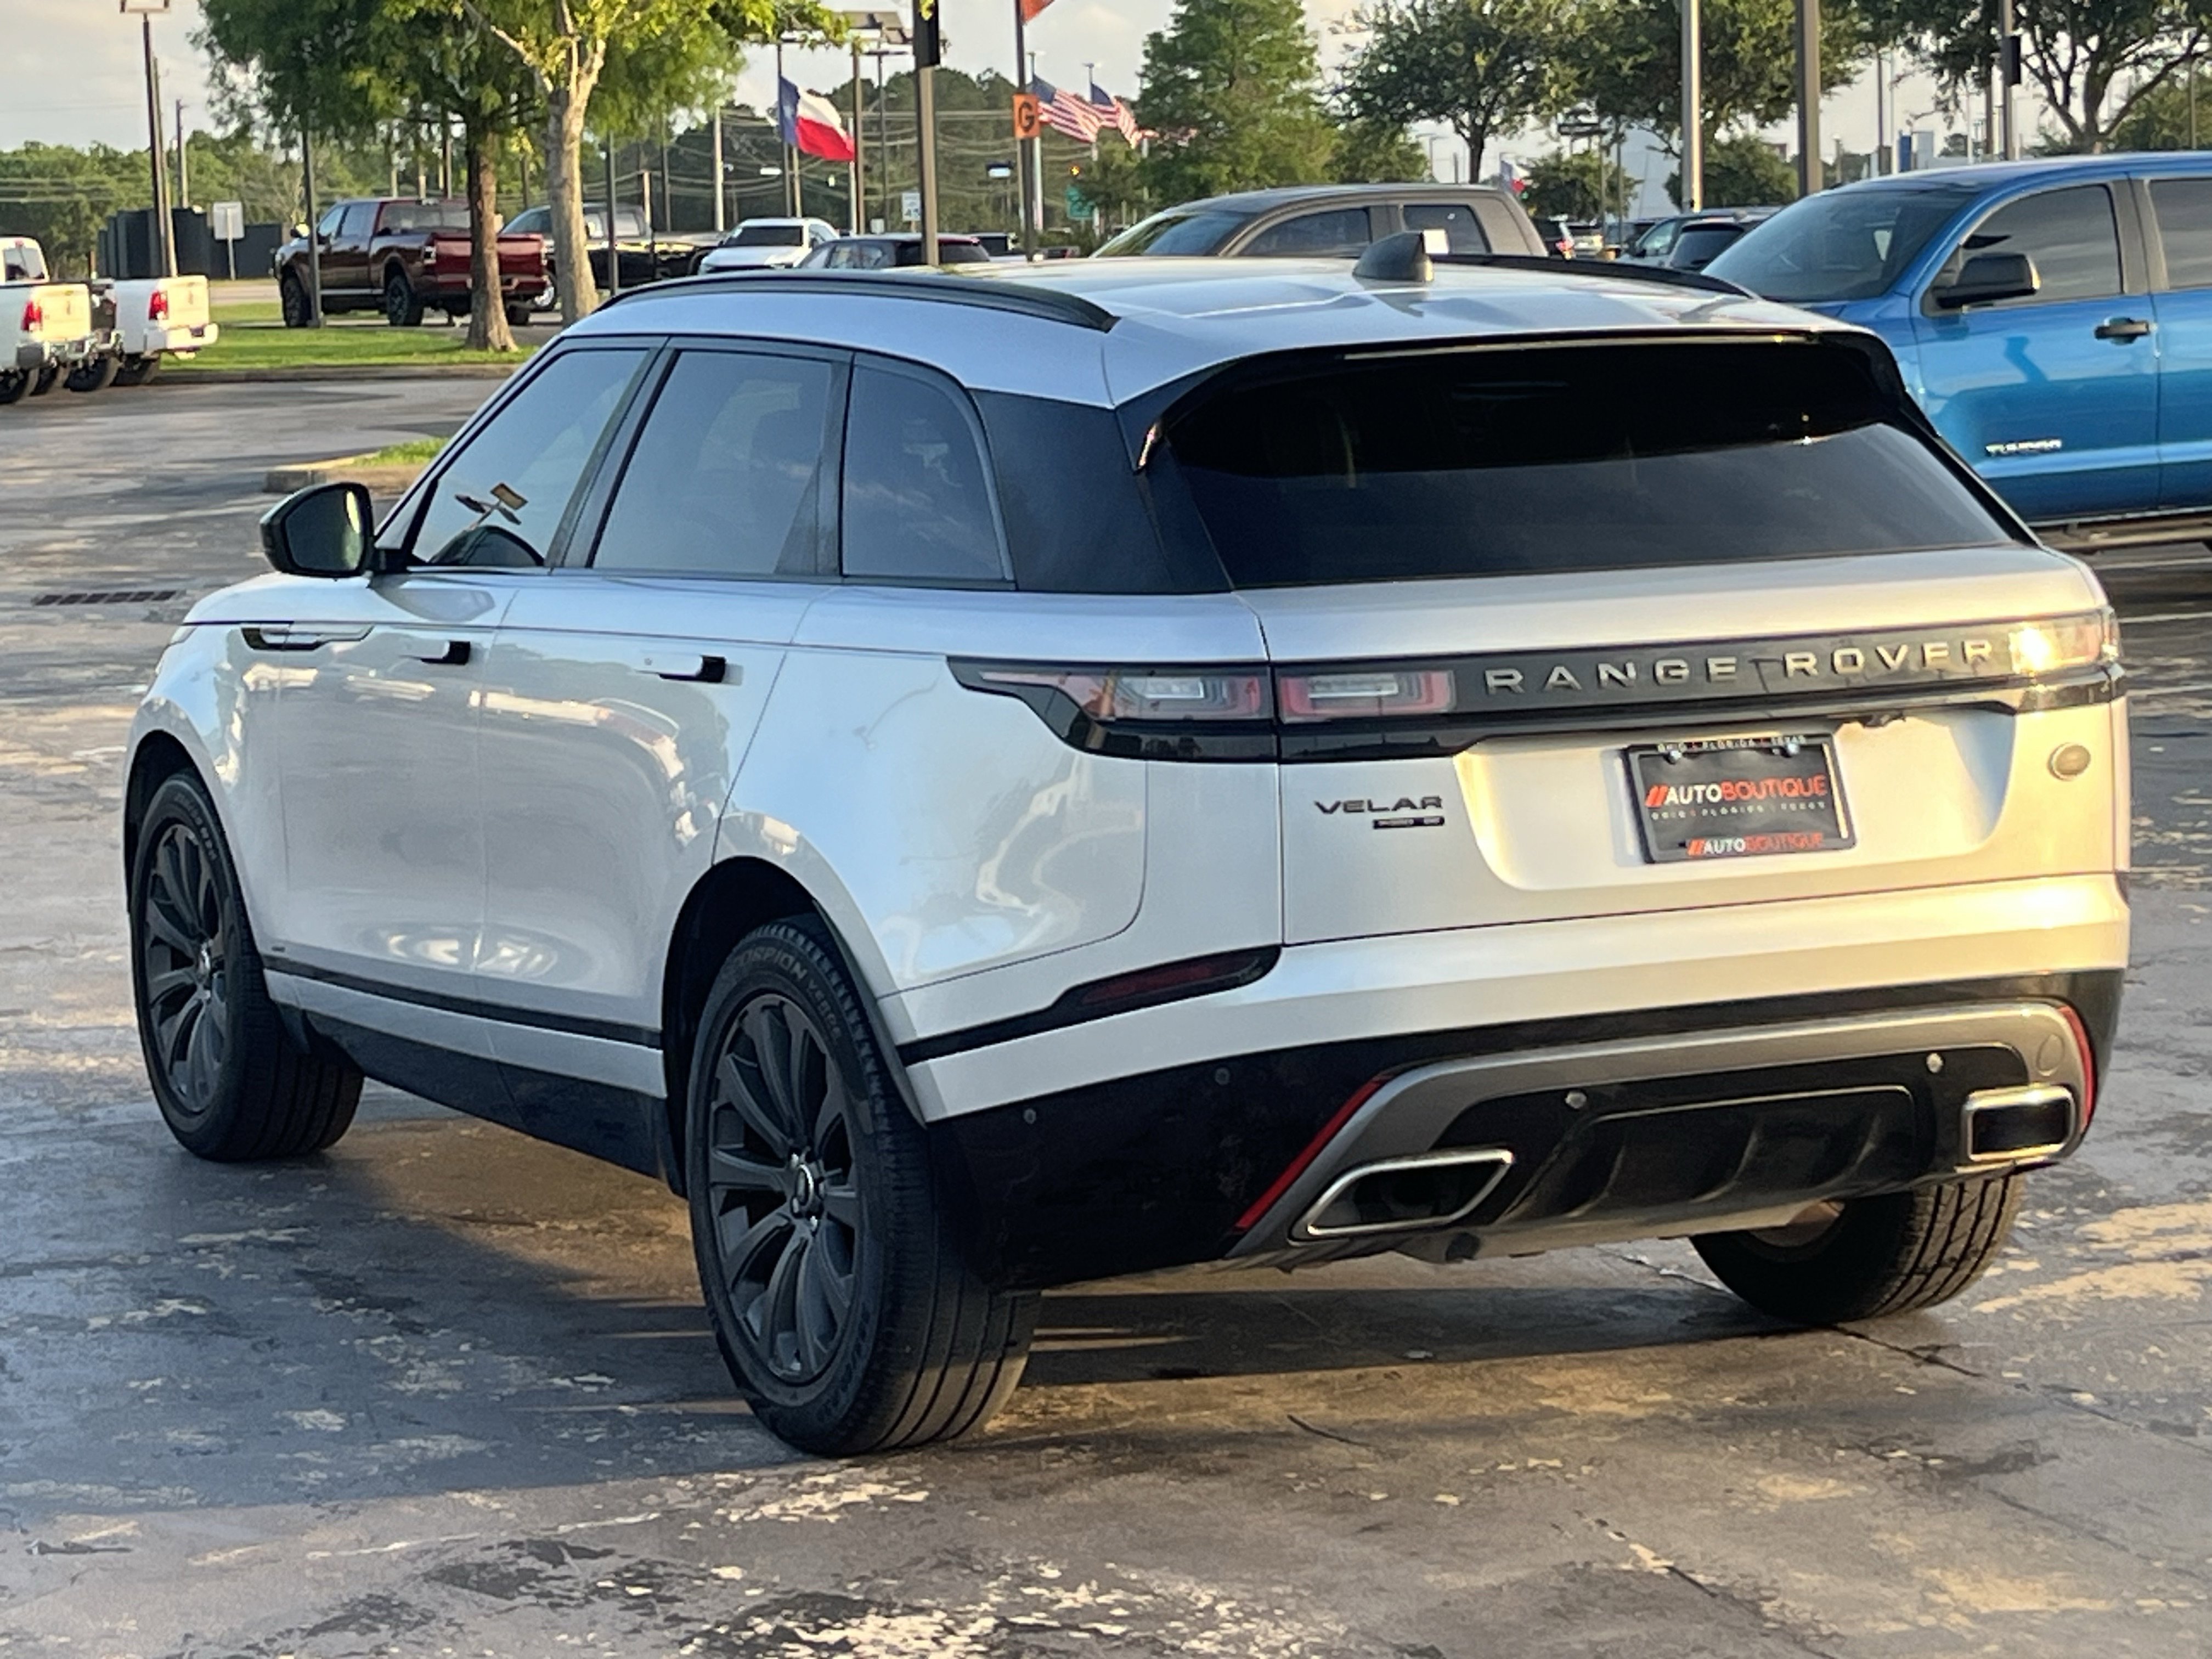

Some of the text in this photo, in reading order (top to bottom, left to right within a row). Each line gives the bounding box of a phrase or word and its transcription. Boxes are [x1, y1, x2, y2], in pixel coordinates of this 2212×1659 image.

[1019, 101, 1035, 133] G
[1485, 640, 1993, 695] RANGE ROVER
[1313, 796, 1442, 814] VELAR
[1664, 775, 1827, 805] AUTOBOUTIQUE
[1702, 832, 1823, 855] AUTOBOUTIQUE
